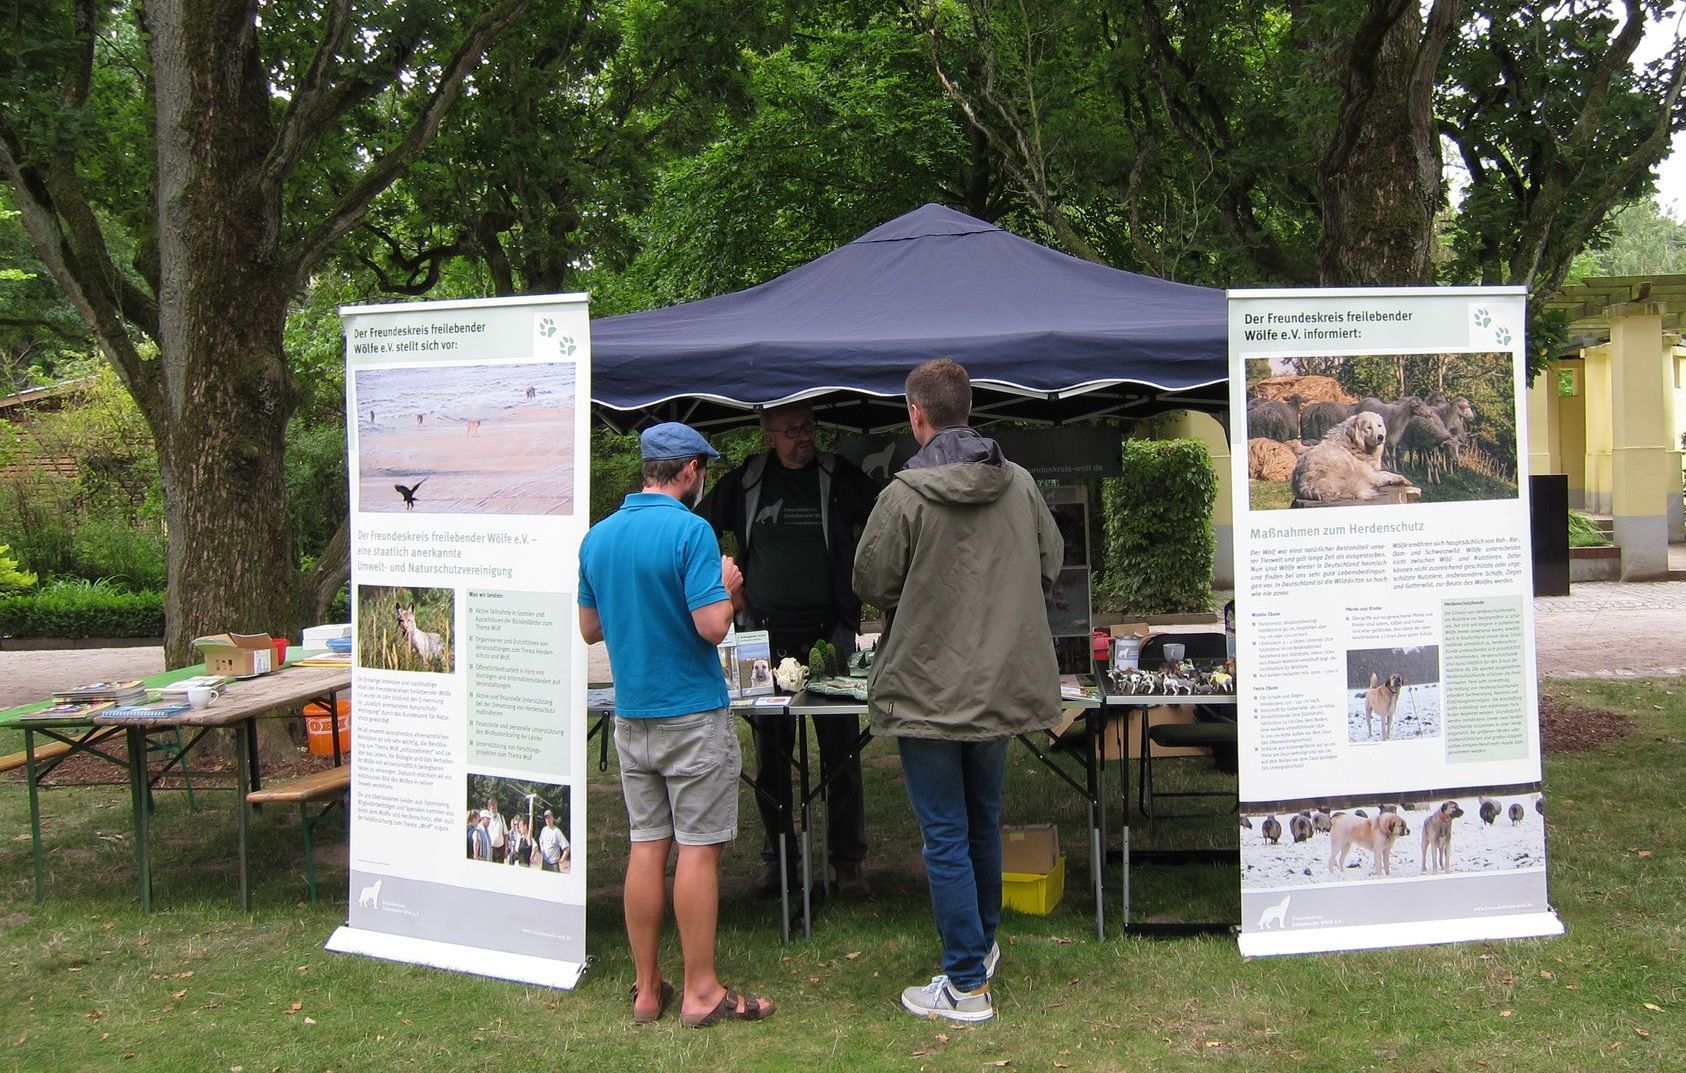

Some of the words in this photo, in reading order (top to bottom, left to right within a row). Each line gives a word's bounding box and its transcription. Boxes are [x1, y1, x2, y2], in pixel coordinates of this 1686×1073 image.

[1245, 314, 1264, 324] Der
[1268, 312, 1344, 324] Freundeskreis
[1347, 311, 1412, 322] freilebender
[354, 328, 367, 338] Der
[370, 325, 428, 337] Freundeskreis
[431, 322, 486, 334] freilebender
[1245, 329, 1278, 341] Wölfe
[1281, 329, 1301, 340] e.V.
[1304, 328, 1362, 339] informiert:
[354, 343, 378, 354] Wölfe
[380, 343, 394, 352] e.V.
[396, 341, 418, 351] stellt
[421, 340, 439, 351] sich
[441, 341, 458, 350] vor:
[358, 530, 369, 540] Der
[371, 531, 429, 542] Freundeskreis
[432, 532, 485, 543] freilebender
[487, 533, 512, 544] Wölfe
[514, 534, 529, 544] e.V.
[1250, 527, 1319, 539] Maßnahmen
[1323, 526, 1345, 535] zum
[1349, 522, 1424, 534] Herdenschutz
[358, 547, 371, 555] eine
[373, 547, 408, 557] staatlich
[411, 548, 462, 558] anerkannte
[358, 562, 387, 572] Umwelt-
[390, 563, 405, 572] und
[408, 563, 512, 578] Naturschutzvereinigung
